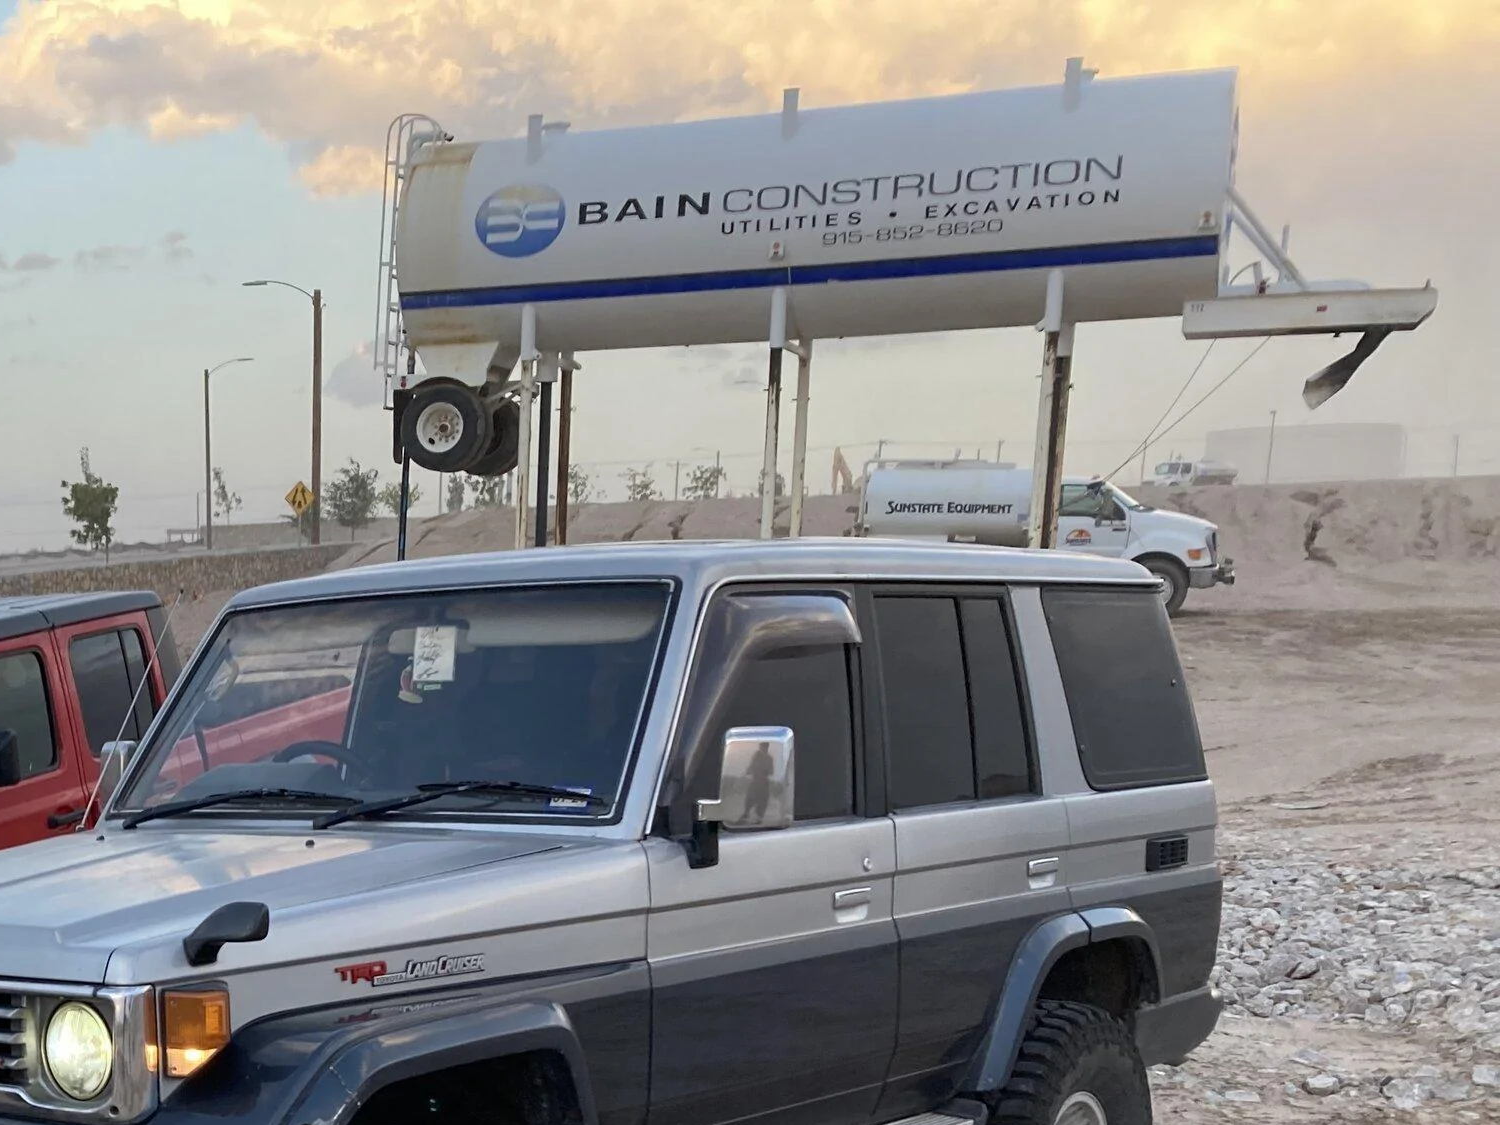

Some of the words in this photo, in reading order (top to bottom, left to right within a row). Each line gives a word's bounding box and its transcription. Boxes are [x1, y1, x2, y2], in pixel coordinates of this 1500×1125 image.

[578, 192, 711, 225] BAIN
[723, 155, 1123, 213] CONSTRUCTION
[721, 210, 863, 235] UTILITIES
[925, 189, 1122, 219] EXCAVATION
[822, 218, 1005, 247] 915-852-8620
